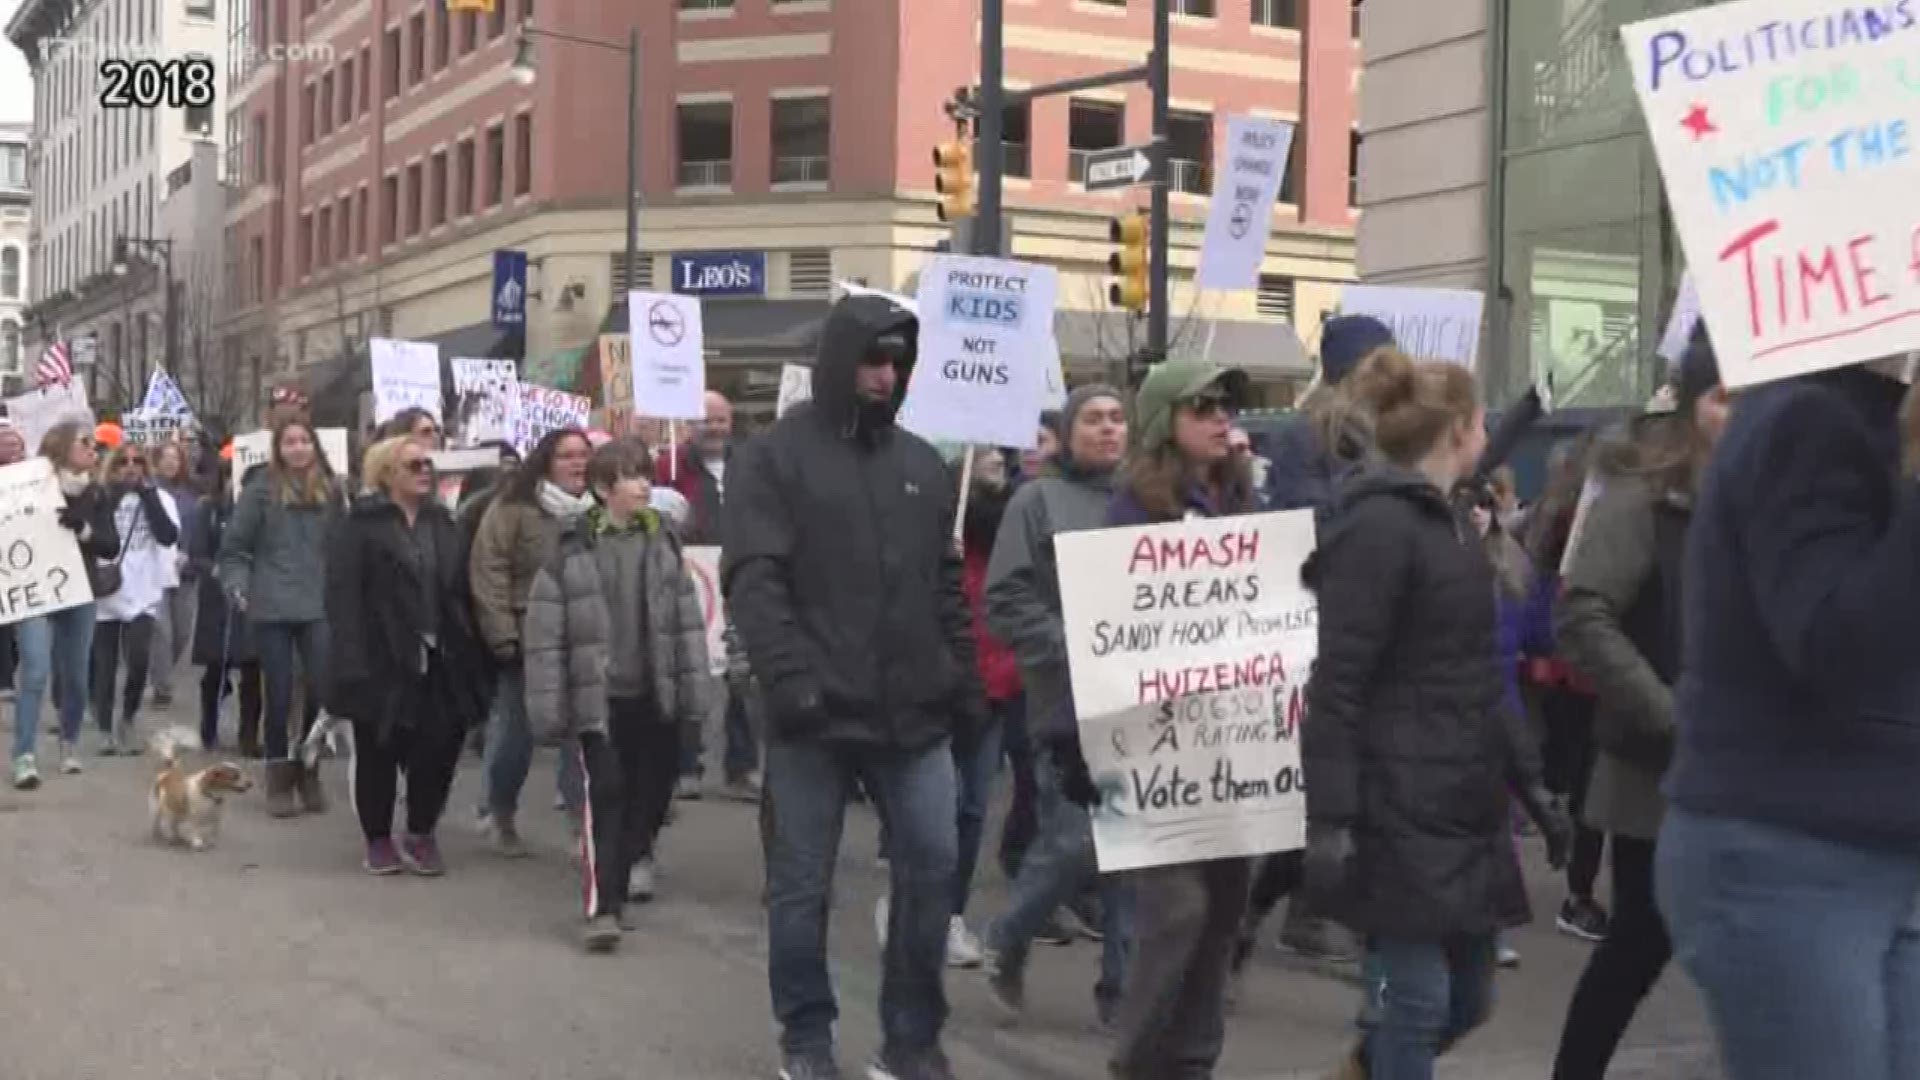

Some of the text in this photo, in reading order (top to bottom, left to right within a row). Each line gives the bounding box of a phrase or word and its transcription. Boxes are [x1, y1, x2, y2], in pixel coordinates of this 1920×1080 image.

[1650, 0, 1915, 91] POLITICIANS
[1767, 66, 1859, 127] FOR
[1709, 119, 1907, 212] NOT THE
[948, 270, 1027, 292] PROTECT
[1719, 219, 1894, 337] TIME
[951, 297, 1018, 322] KIDS
[963, 337, 997, 354] NOT
[943, 360, 1009, 385] GUNS
[1128, 529, 1259, 575] AMASH
[1133, 575, 1259, 611] BREAKS
[1091, 620, 1163, 657] SANDY
[1170, 614, 1230, 646] HOOK
[1138, 652, 1287, 702] HUIZENGA
[1193, 718, 1269, 749] RATING
[1132, 766, 1203, 811] Vote
[1210, 756, 1269, 803] them
